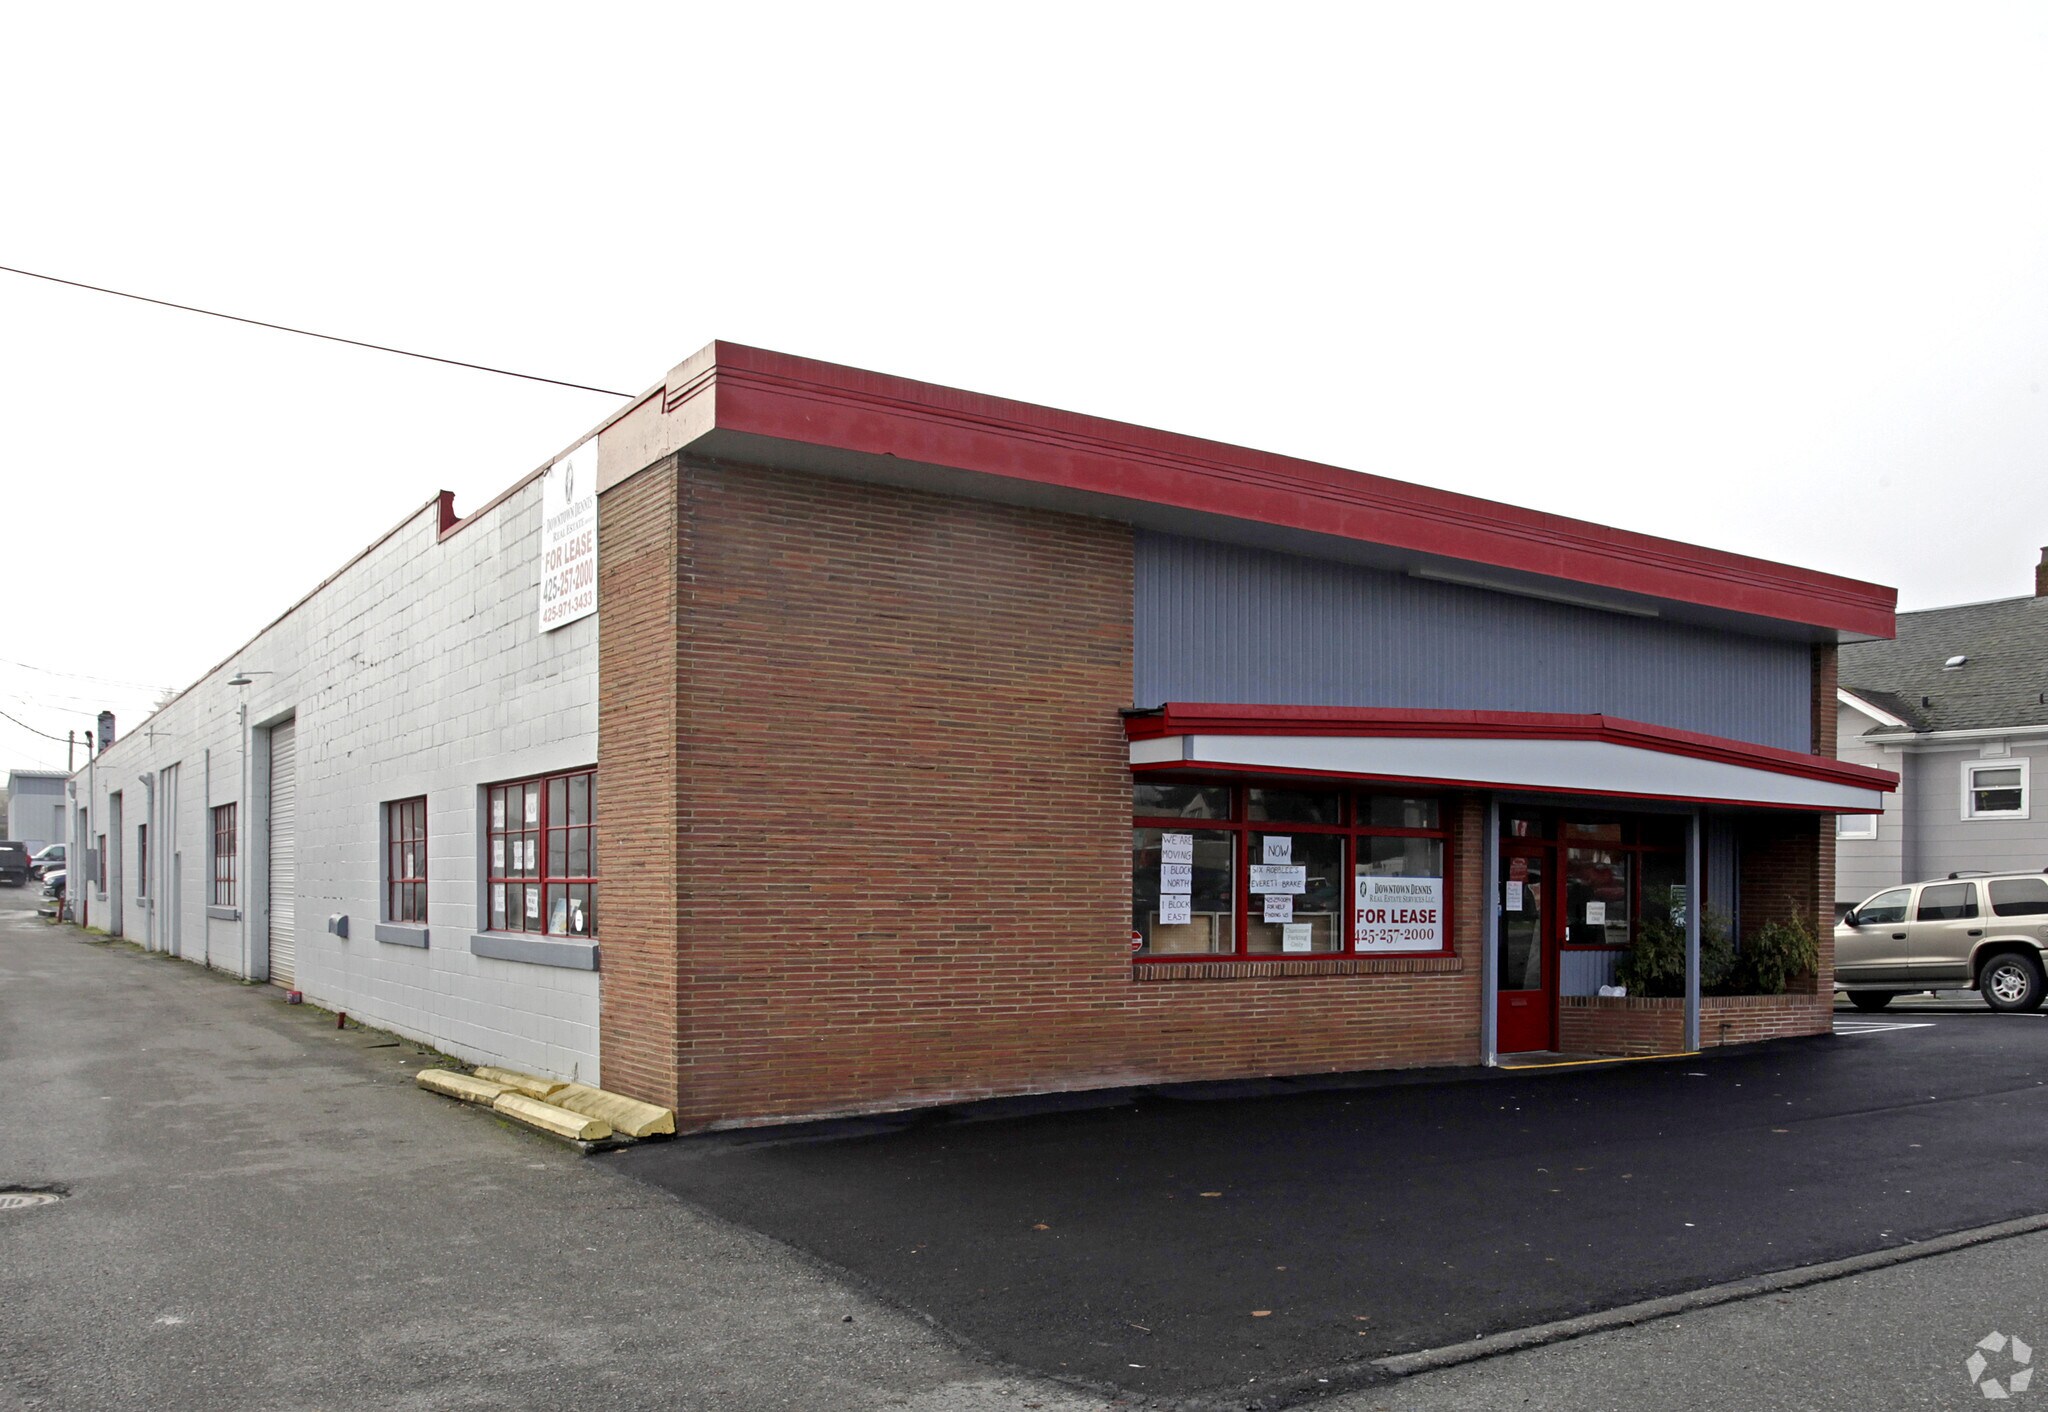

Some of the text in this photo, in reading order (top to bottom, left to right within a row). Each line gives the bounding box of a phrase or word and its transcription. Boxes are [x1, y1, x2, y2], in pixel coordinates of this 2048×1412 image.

[553, 529, 565, 542] REAL
[567, 517, 584, 535] ESTATE
[545, 530, 592, 573] FOR LEASE
[543, 558, 593, 603] 425-257-2000
[543, 590, 592, 623] 425-971-3433
[1162, 835, 1192, 845] WE ARE
[1162, 850, 1191, 860] MOVING
[1268, 845, 1289, 857] NOW
[1170, 866, 1192, 875] BLOCK
[1167, 879, 1190, 887] NORTH
[1251, 880, 1277, 888] EVERETT
[1375, 883, 1432, 895] DOWNTOWN DENNIS
[1369, 894, 1382, 902] REAL
[1402, 895, 1424, 903] SERVICES
[1168, 901, 1190, 909] BLOCK
[1167, 913, 1188, 921] EAST
[1357, 909, 1436, 923] FOR LEASE
[1354, 928, 1434, 944] 425-257-2000
